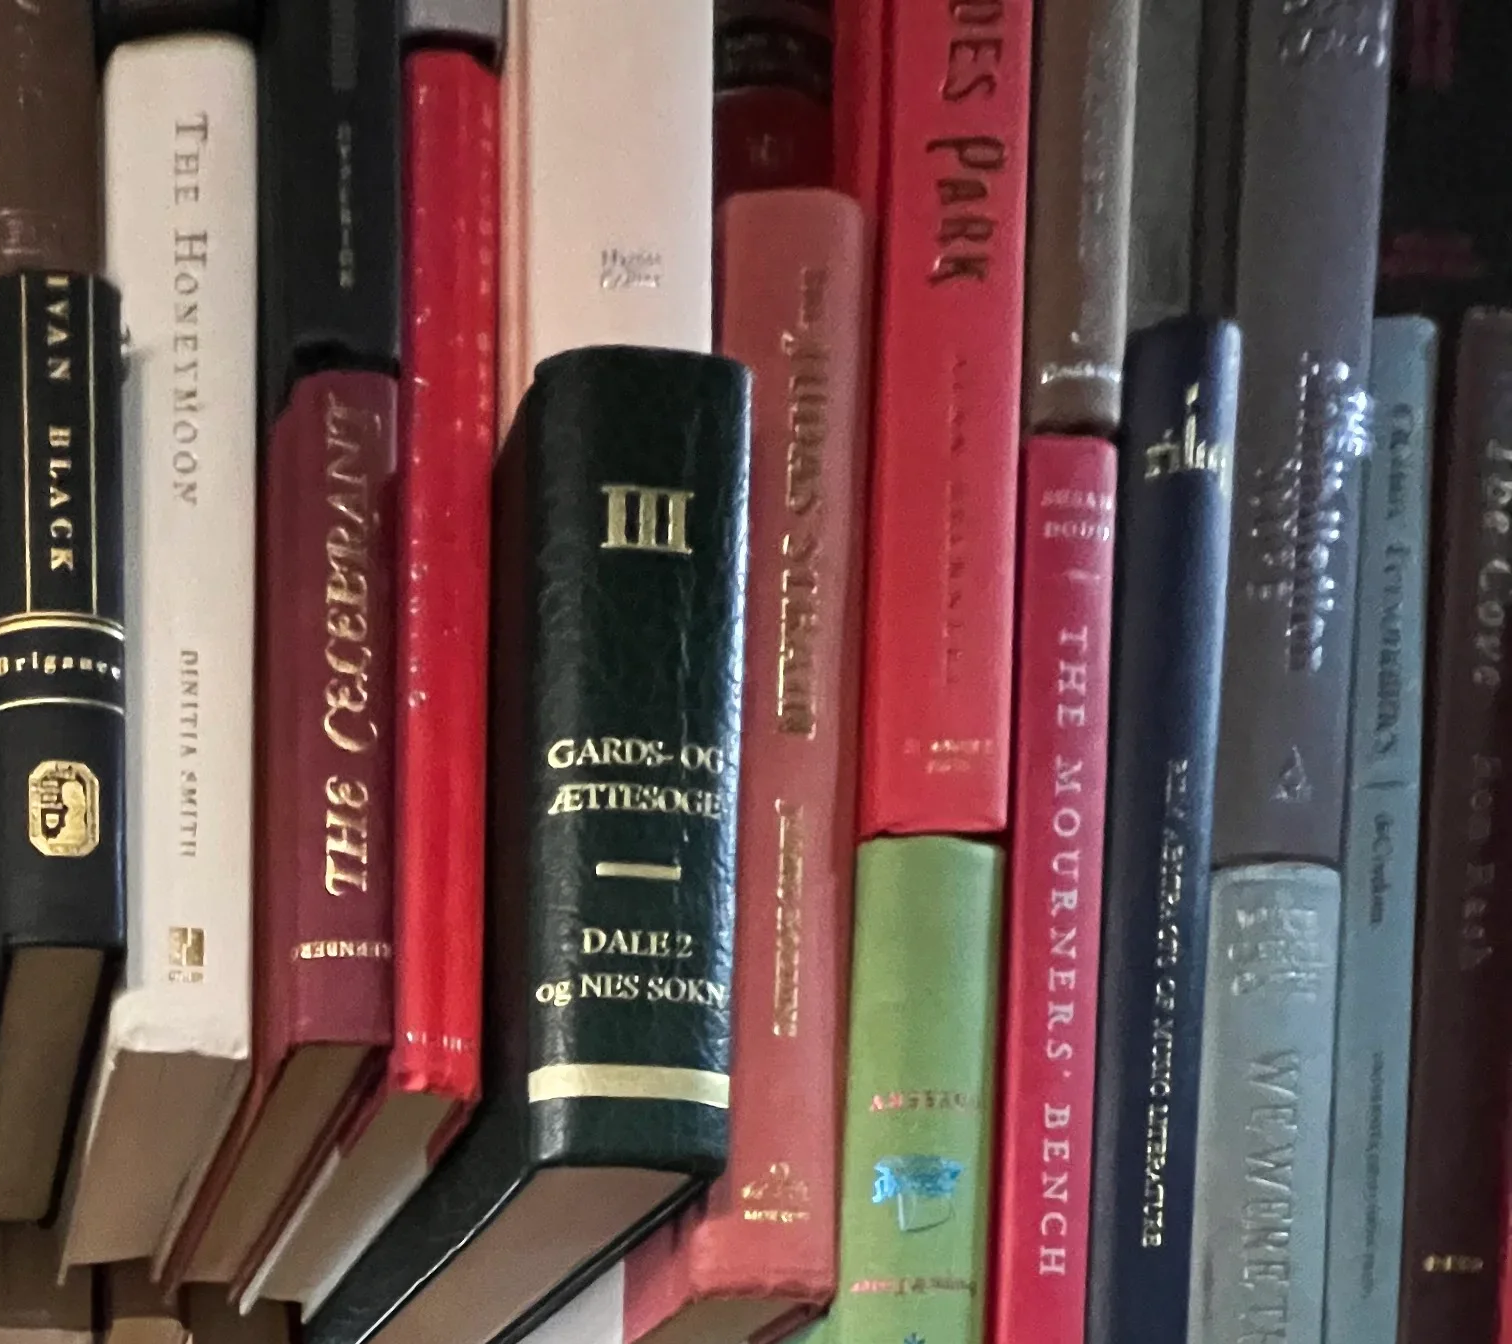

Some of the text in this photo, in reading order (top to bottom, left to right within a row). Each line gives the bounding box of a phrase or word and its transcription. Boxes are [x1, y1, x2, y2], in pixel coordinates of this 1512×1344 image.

[926, 134, 1004, 285] PARK
[172, 112, 208, 507] THE HONEYMOON
[47, 425, 74, 572] BLACK
[601, 484, 694, 555] III
[322, 394, 382, 753] CELEBRANT
[180, 768, 198, 858] SMITH
[546, 738, 724, 773] GARDS- OG
[324, 775, 369, 897] THE
[534, 972, 726, 1007] og NES SOKN
[582, 927, 672, 958] DALE
[1038, 625, 1087, 1276] THE MOURNERS' BENCH
[1141, 1101, 1171, 1249] LITERATURE
